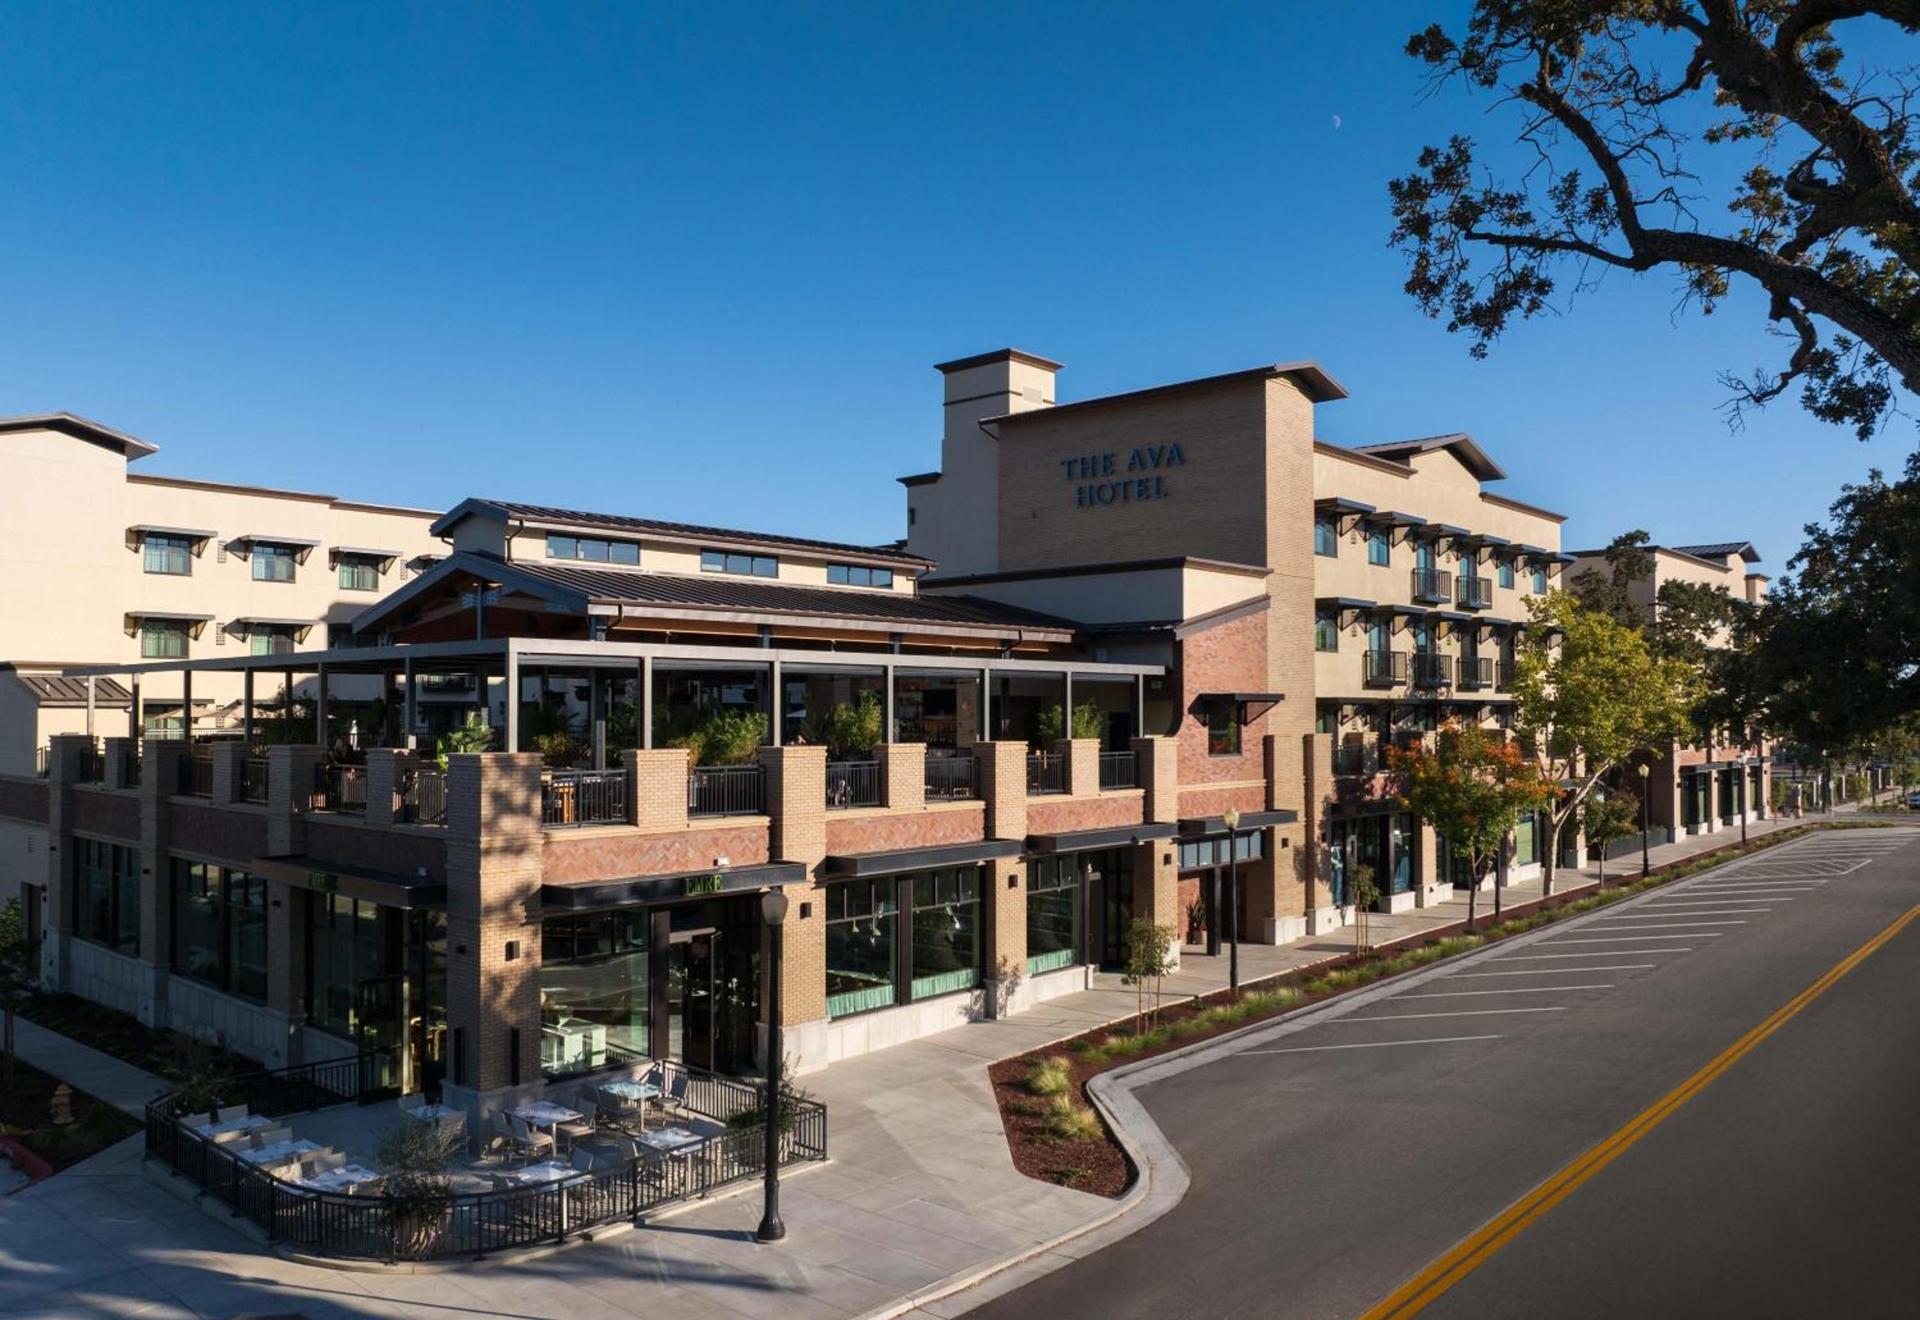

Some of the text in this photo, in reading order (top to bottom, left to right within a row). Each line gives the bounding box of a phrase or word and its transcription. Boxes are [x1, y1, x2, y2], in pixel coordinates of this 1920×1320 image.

[1060, 442, 1185, 481] THE AVA
[1075, 475, 1169, 509] HOTEL
